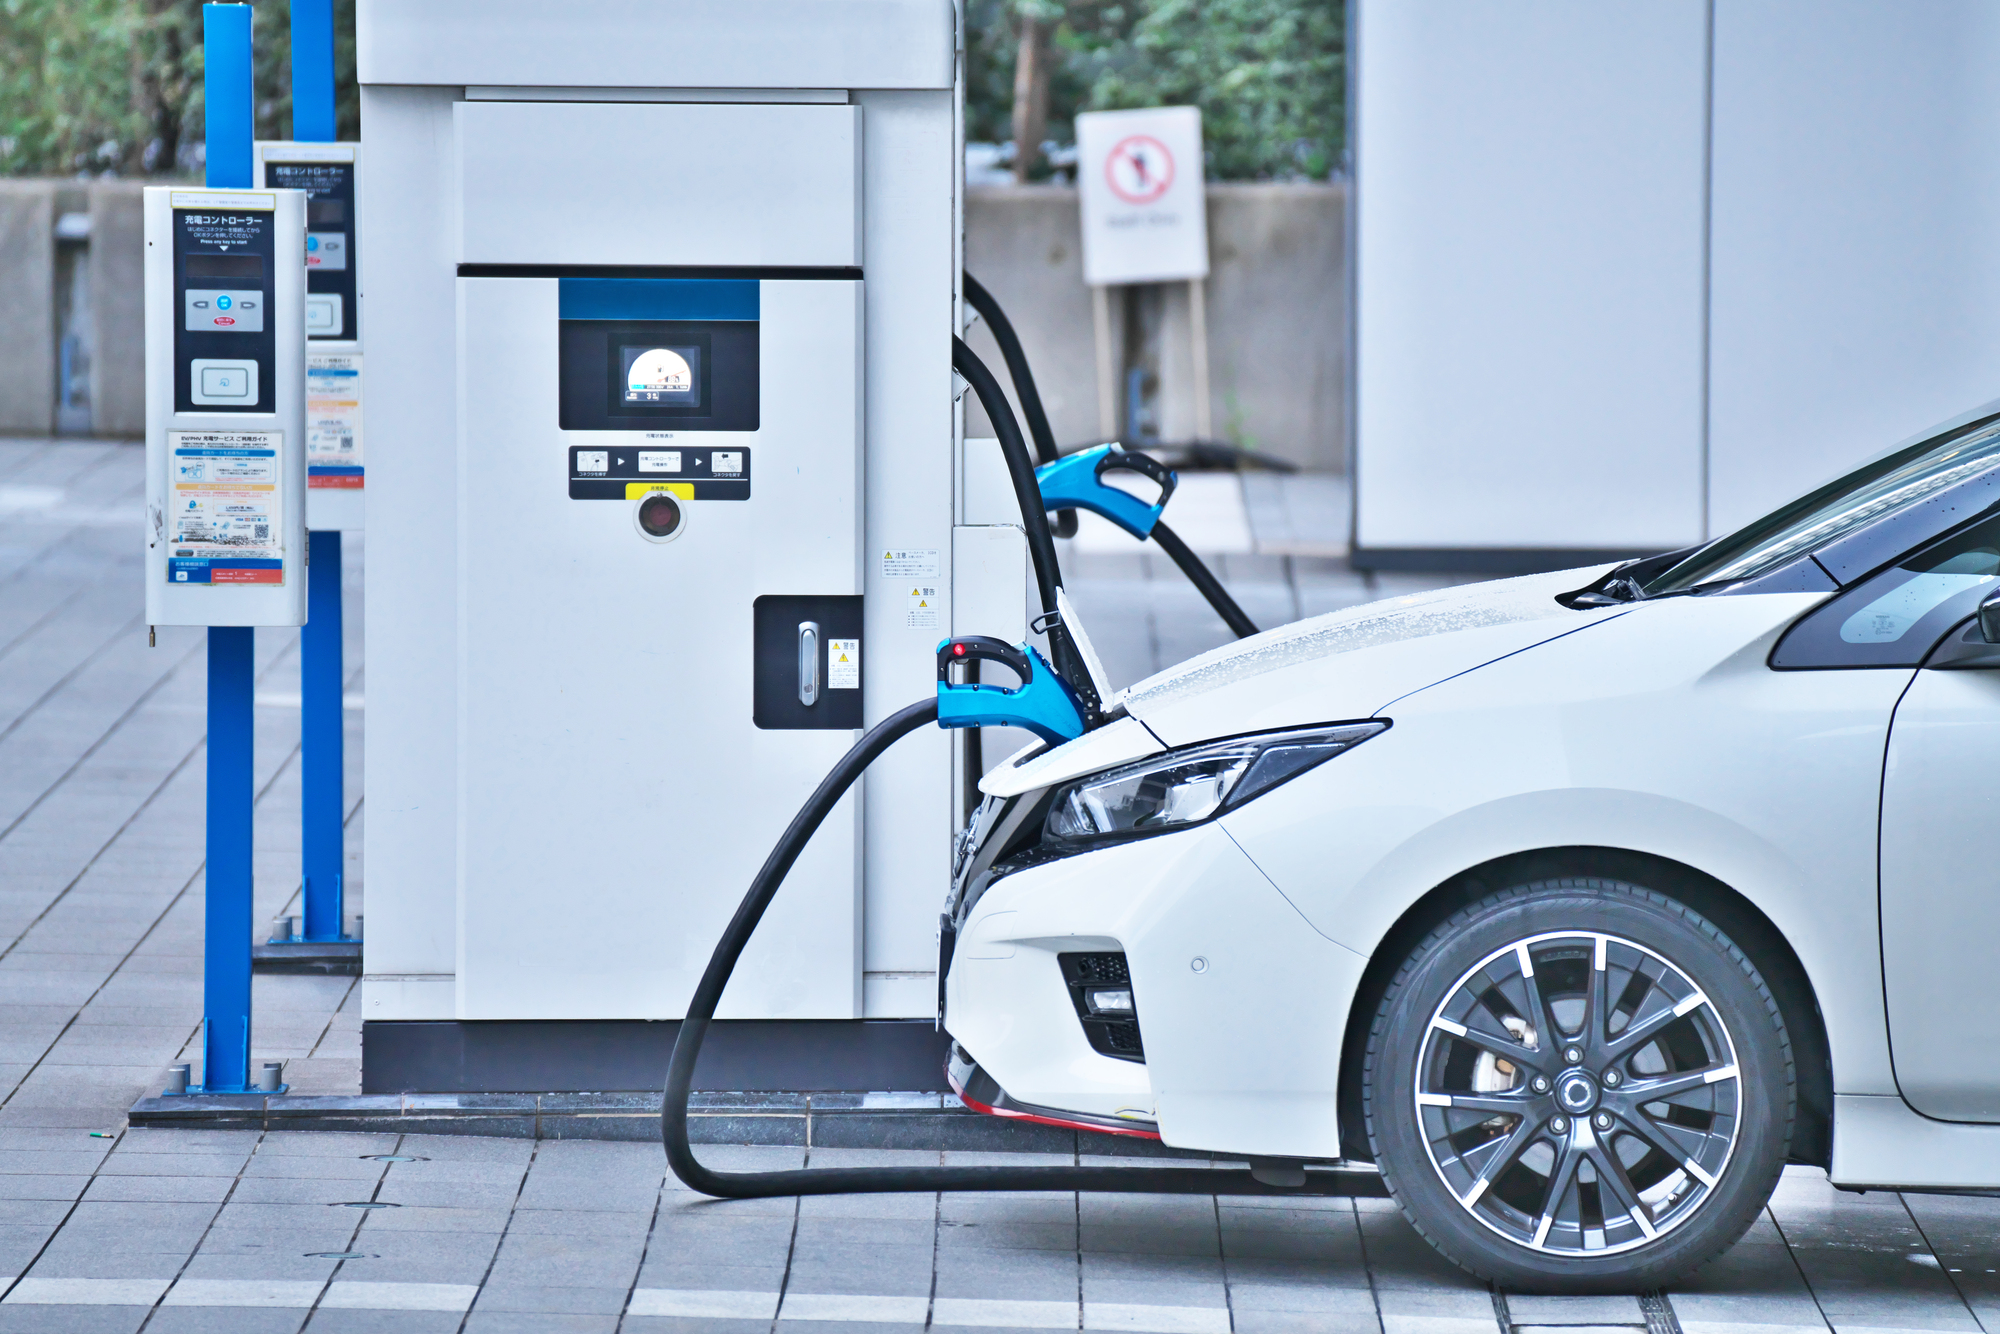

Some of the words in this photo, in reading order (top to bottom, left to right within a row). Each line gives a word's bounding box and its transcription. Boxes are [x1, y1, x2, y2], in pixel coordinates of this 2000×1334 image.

[184, 214, 263, 225] 充電コントローラー
[922, 587, 936, 596] 警告
[843, 642, 855, 650] 警告
